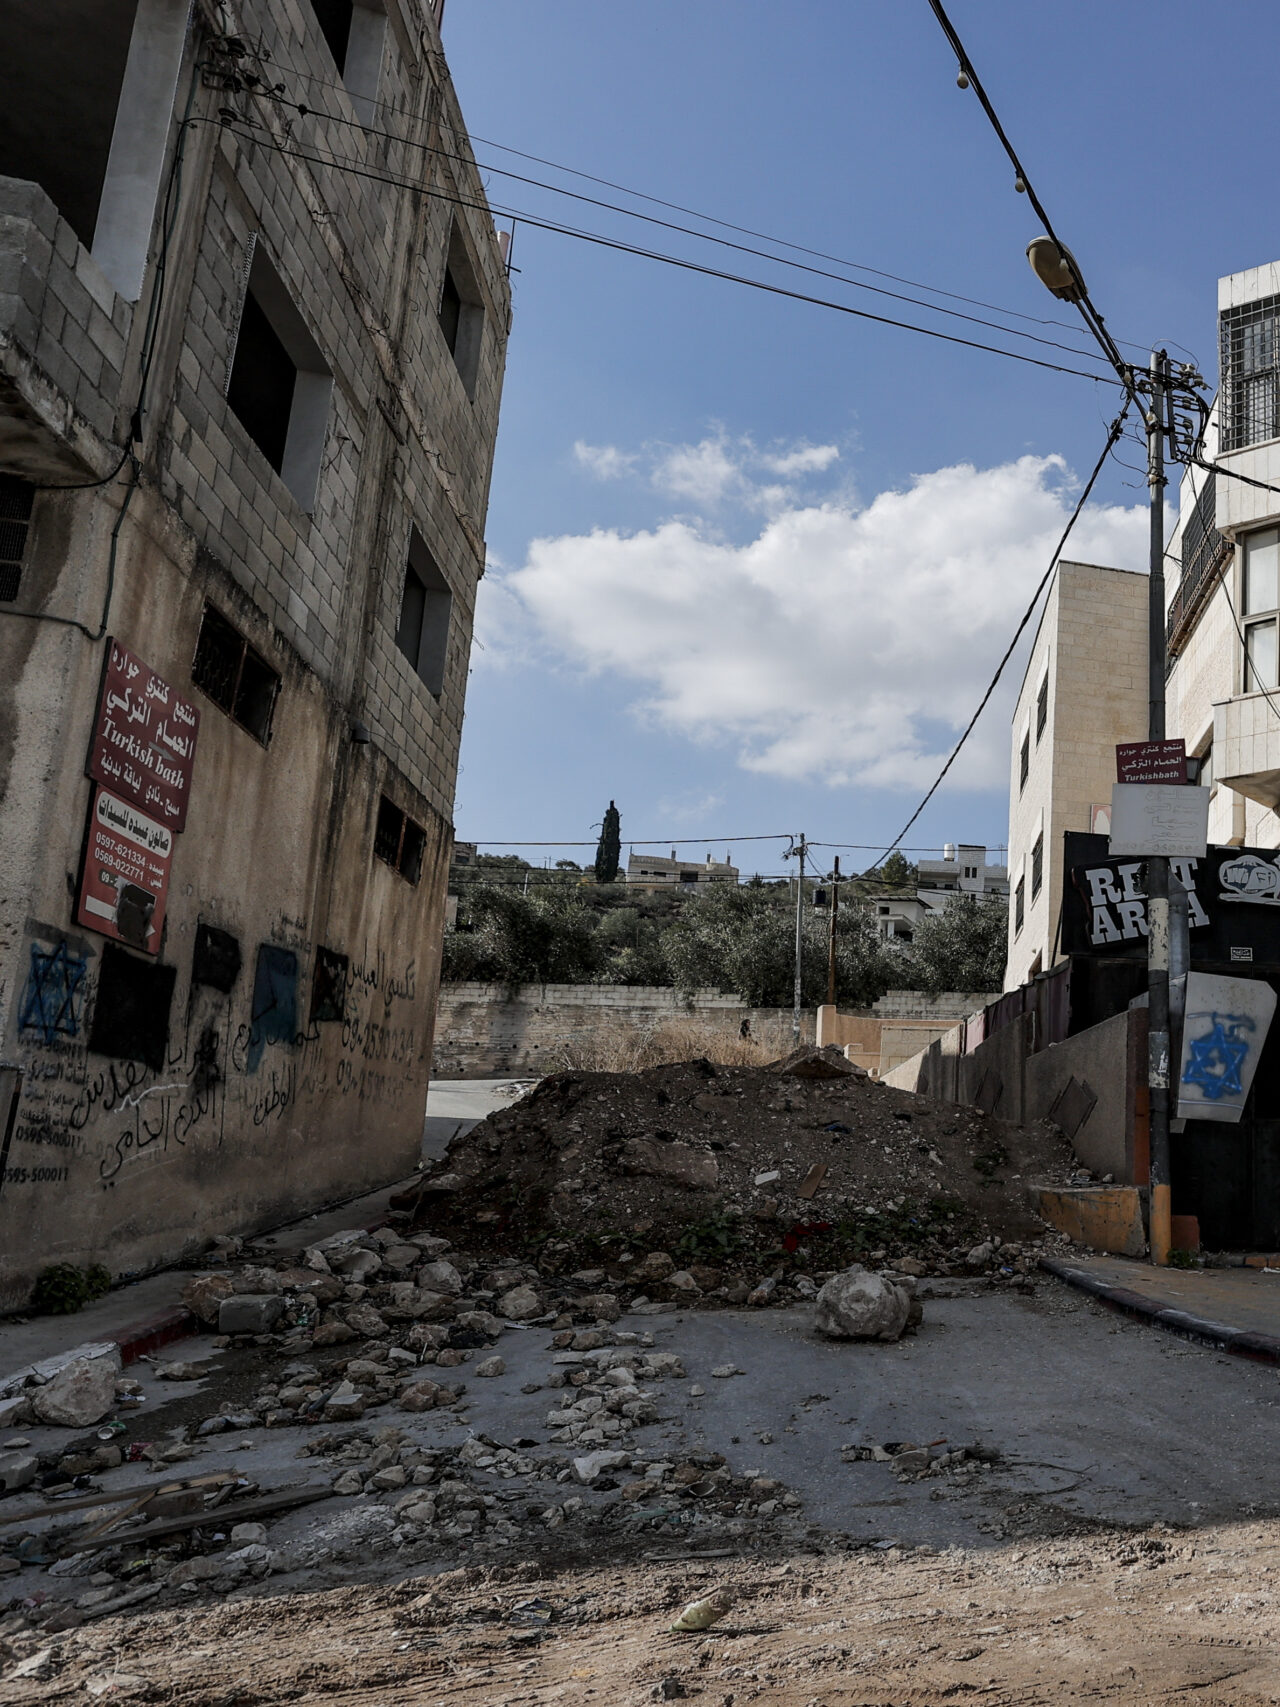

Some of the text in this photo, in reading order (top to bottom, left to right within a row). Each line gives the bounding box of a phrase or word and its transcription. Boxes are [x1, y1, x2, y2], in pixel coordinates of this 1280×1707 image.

[112, 649, 195, 726] منتجع كنتري حواره
[106, 687, 194, 760] الحمام التركي
[100, 748, 122, 781] بدنية
[102, 717, 184, 789] Turkish bath
[1119, 744, 1183, 757] منتجع كنتري حواره
[1121, 757, 1182, 771] الحمام التركي
[123, 762, 142, 793] لياقة
[1125, 771, 1179, 782] Turkishbath
[99, 798, 129, 829] للسيدات
[96, 831, 146, 867] 0597-621334
[148, 829, 170, 851] صالون
[94, 848, 145, 881] 0569-022771
[1085, 857, 1201, 907] RET
[1091, 889, 1211, 945] ARA
